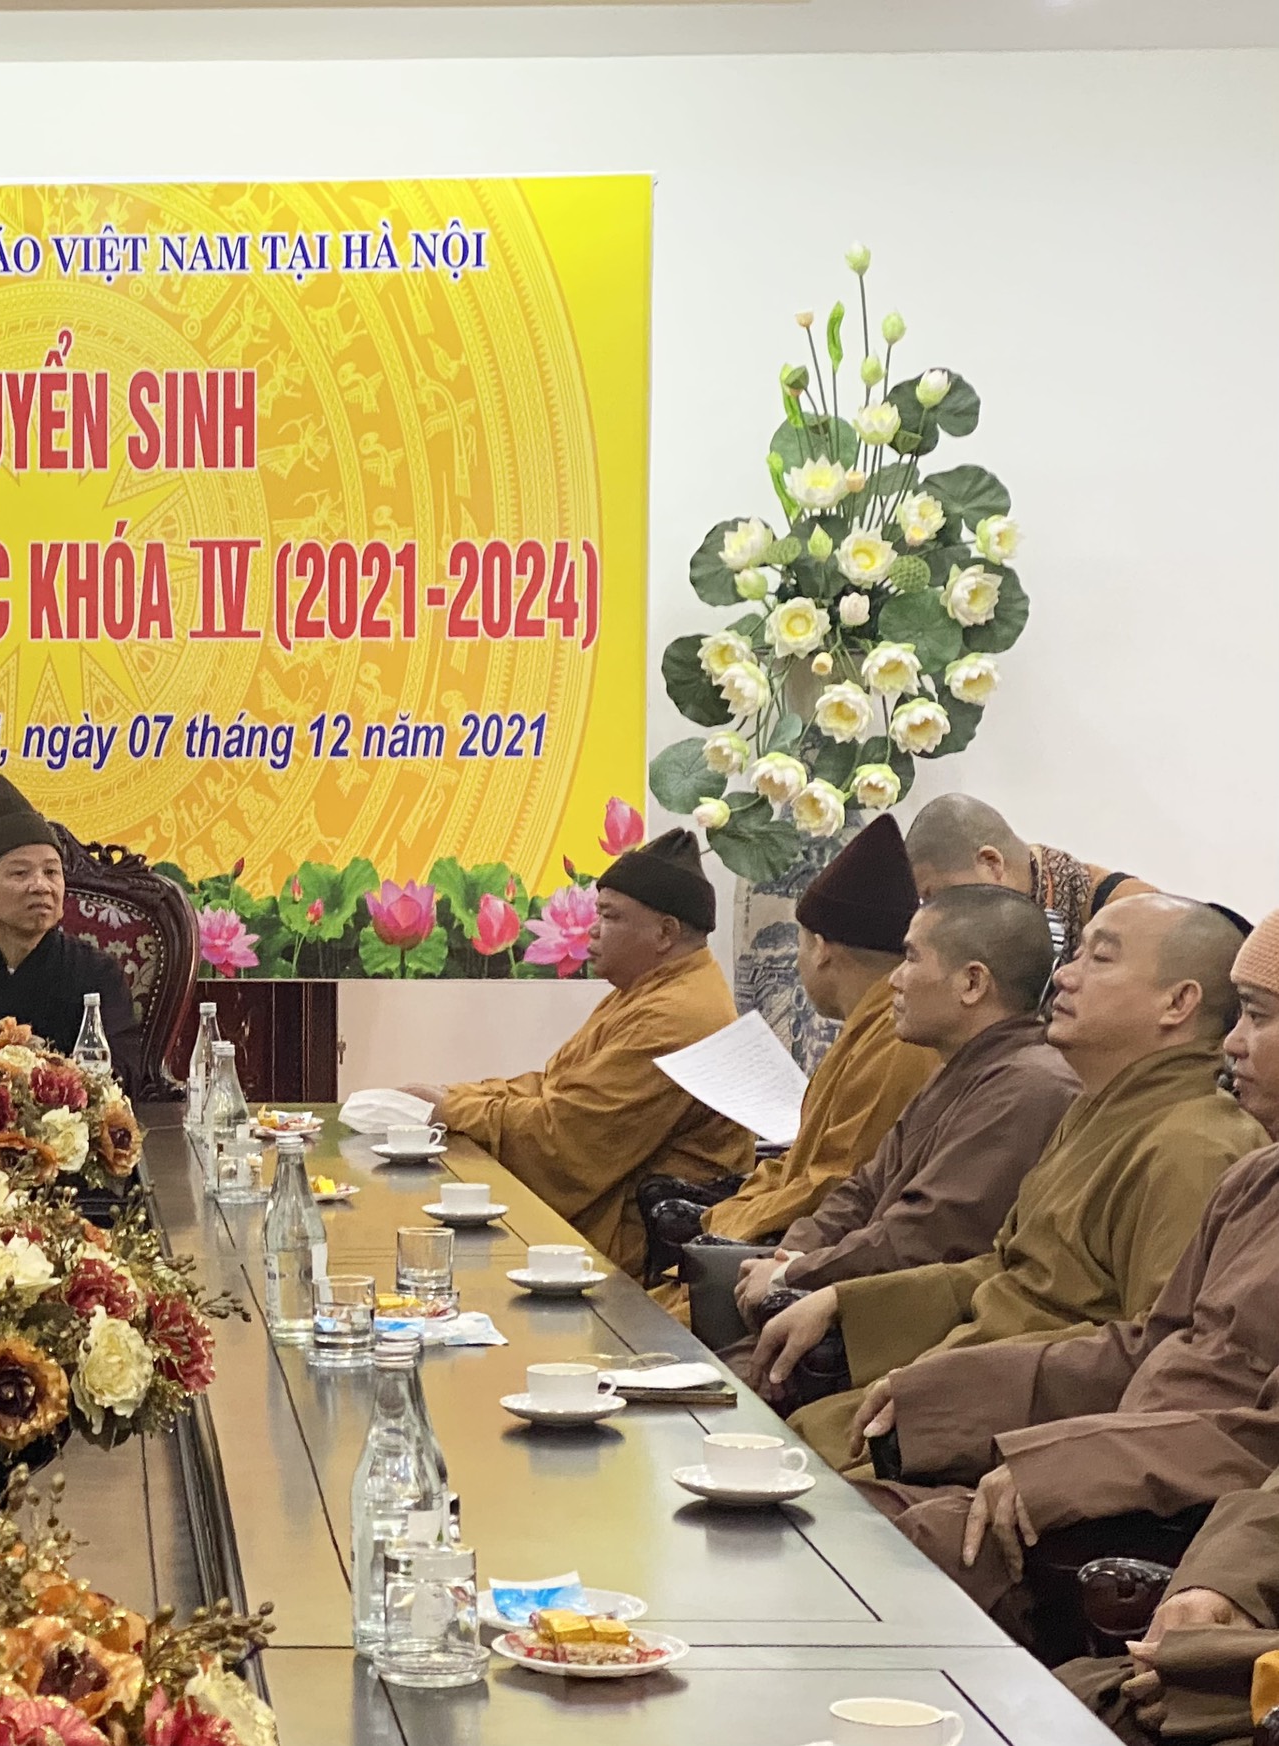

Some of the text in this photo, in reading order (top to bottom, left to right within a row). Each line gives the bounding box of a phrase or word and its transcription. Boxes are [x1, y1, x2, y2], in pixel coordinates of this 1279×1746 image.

[54, 224, 148, 282] VIỆT
[159, 235, 250, 272] NAM
[261, 234, 329, 280] TẠI
[342, 221, 399, 269] HÀ
[410, 219, 487, 278] NỘI
[128, 370, 255, 470] SINH
[30, 520, 173, 641] KHÓA
[189, 539, 262, 639] IV
[23, 713, 117, 770] ngày
[128, 714, 174, 758] 07
[186, 712, 294, 770] tháng
[309, 713, 352, 758] 12
[363, 712, 445, 758] năm
[458, 712, 547, 758] 2021
